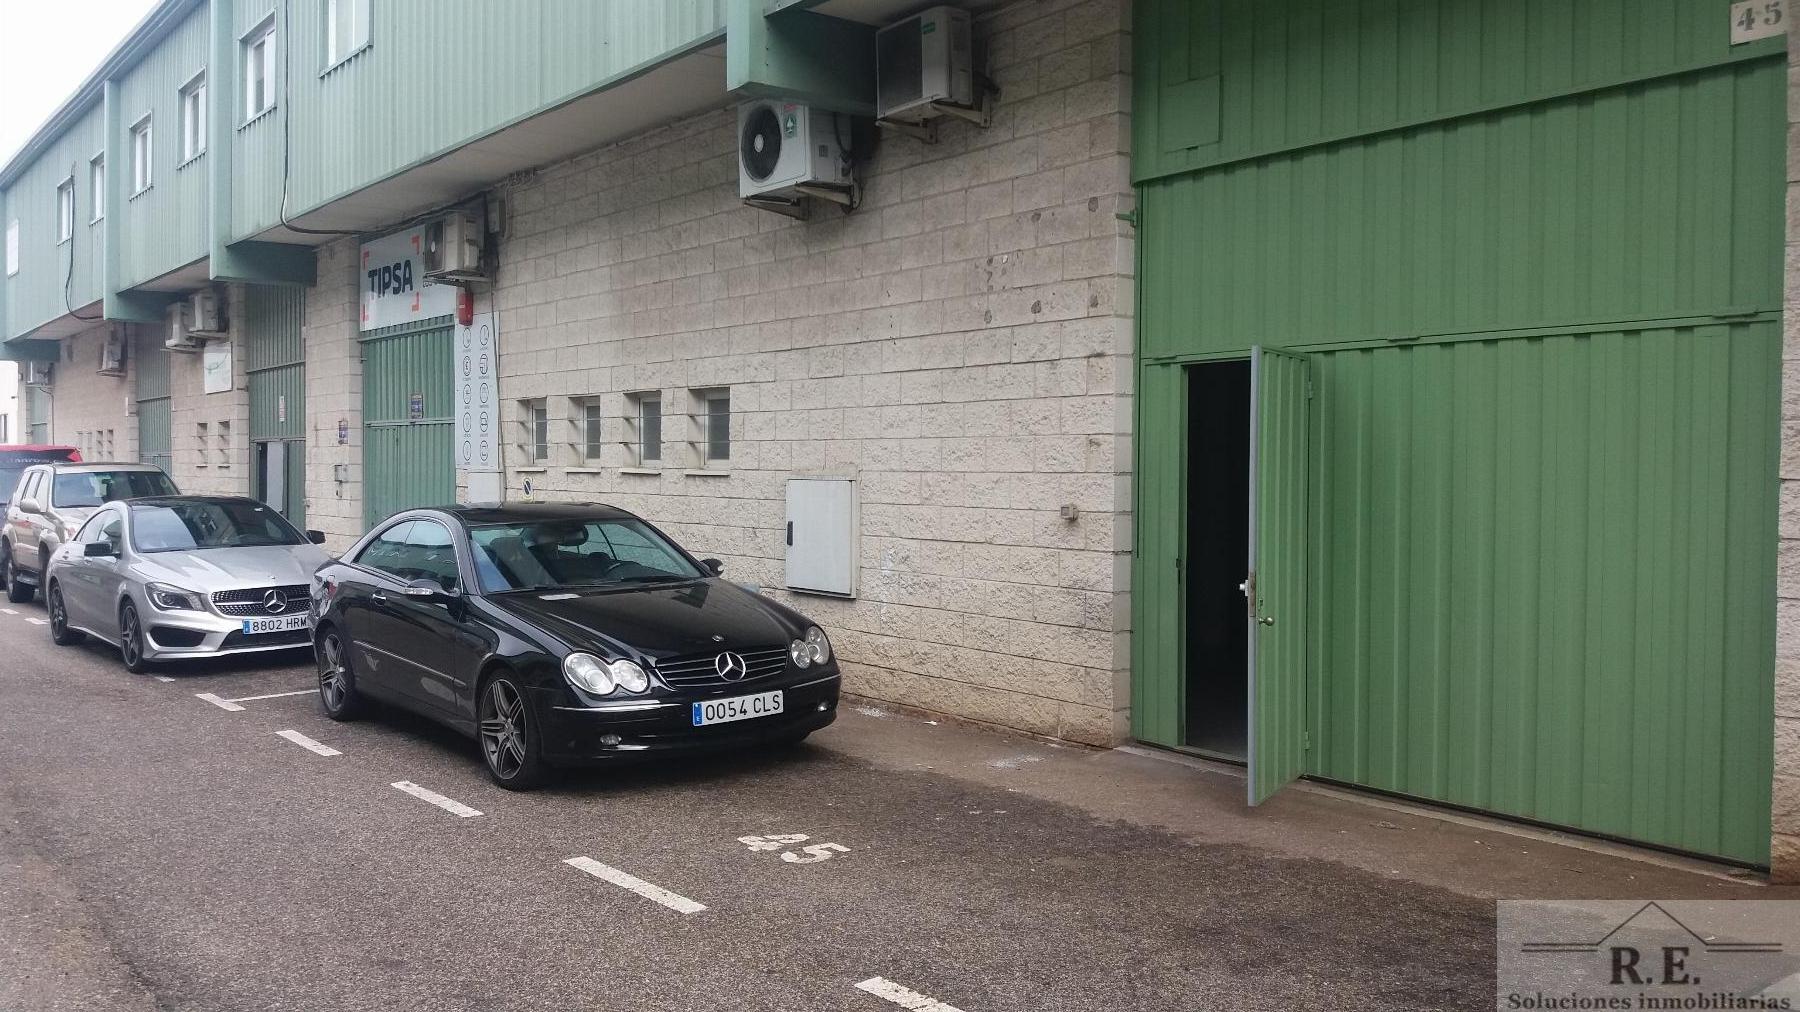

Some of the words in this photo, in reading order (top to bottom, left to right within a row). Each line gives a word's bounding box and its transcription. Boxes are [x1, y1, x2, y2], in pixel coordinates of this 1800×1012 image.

[1736, 1, 1782, 31] 45
[367, 259, 413, 300] TIPSA
[252, 619, 283, 632] 8802
[286, 616, 307, 629] HRM
[705, 699, 748, 721] 0054
[753, 694, 781, 714] CLS
[737, 833, 851, 863] 45
